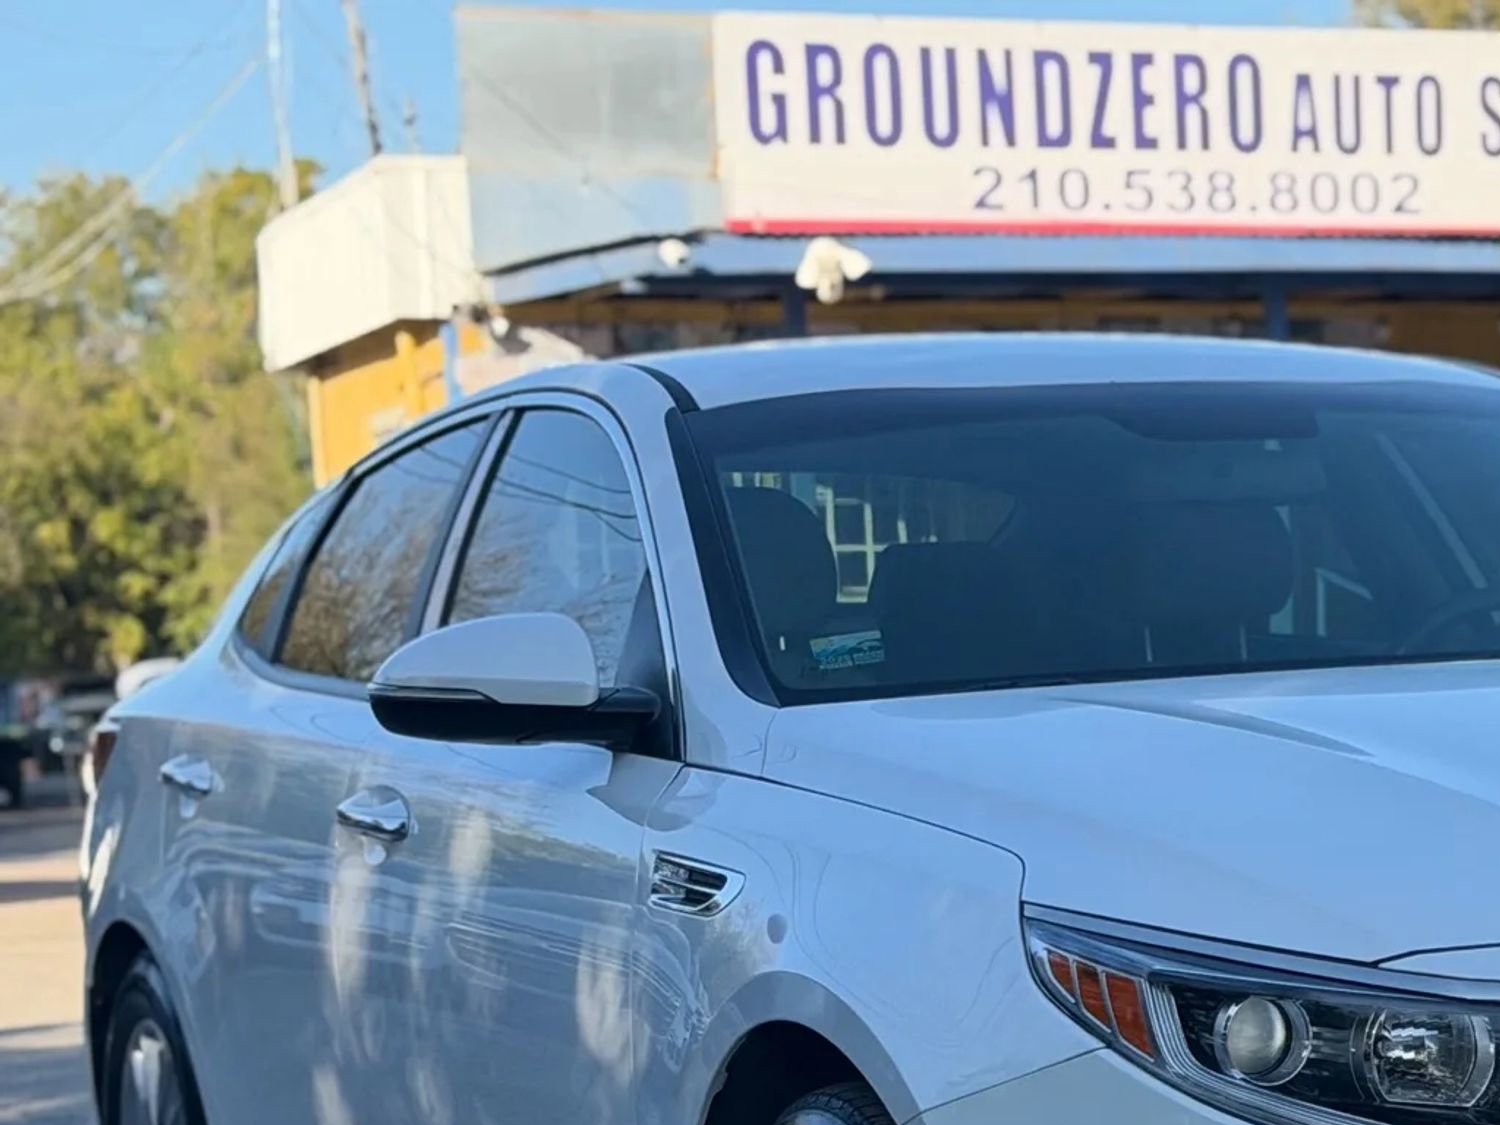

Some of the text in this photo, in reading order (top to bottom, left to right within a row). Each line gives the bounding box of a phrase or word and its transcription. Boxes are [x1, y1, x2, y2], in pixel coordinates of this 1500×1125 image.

[745, 39, 1262, 153] GROUNDZERO
[1291, 73, 1442, 156] AUTO
[973, 165, 1422, 215] 210.538.8002
